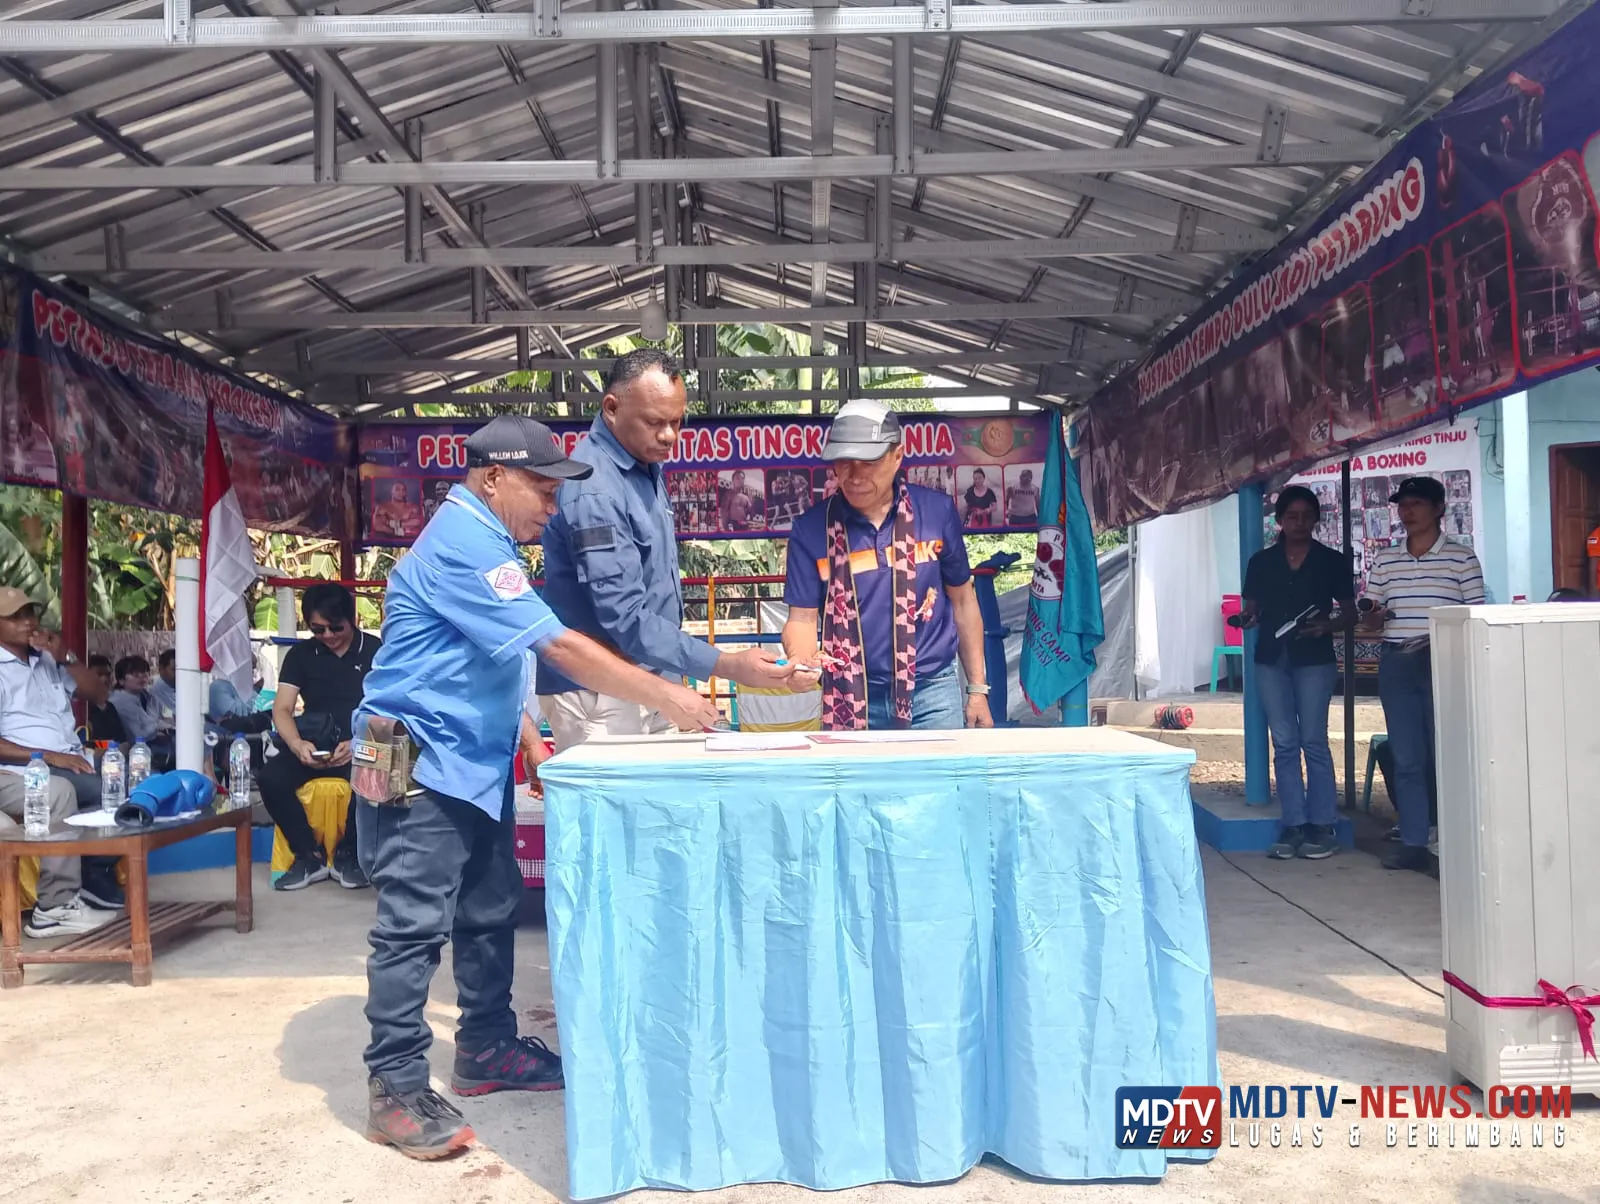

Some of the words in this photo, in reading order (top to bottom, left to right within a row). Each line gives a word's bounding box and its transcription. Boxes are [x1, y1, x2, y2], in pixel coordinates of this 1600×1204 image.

[1190, 304, 1232, 368] TEMPO
[1232, 272, 1273, 339] DULU
[1308, 156, 1425, 289] PETARUNG
[735, 424, 833, 461] TINGK
[1434, 431, 1468, 444] TINJU
[1367, 451, 1427, 470] BOXING
[1041, 631, 1071, 662] CAMP
